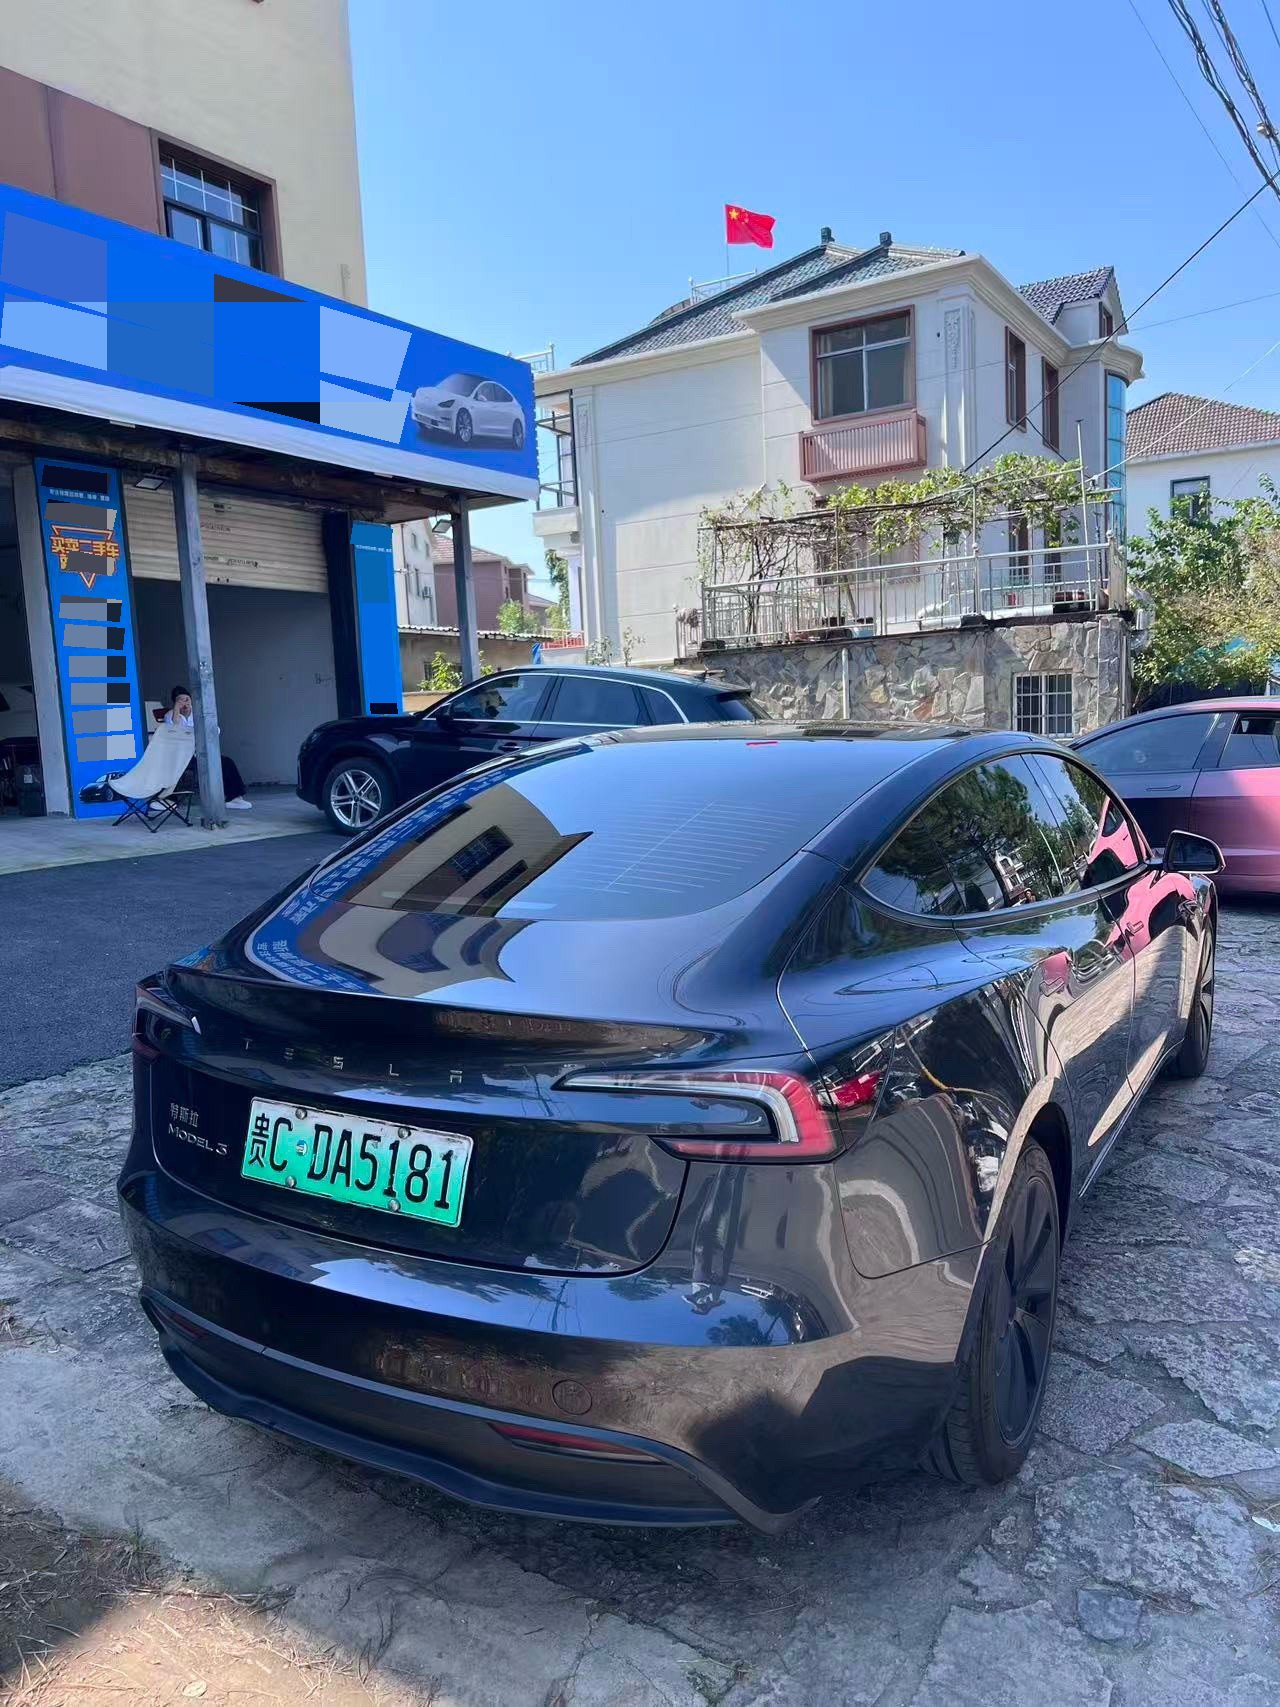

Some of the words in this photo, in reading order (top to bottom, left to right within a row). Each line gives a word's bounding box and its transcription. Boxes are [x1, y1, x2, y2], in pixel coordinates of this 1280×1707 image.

[243, 1038, 463, 1083] TESLA
[170, 1102, 199, 1127] 特斯拉
